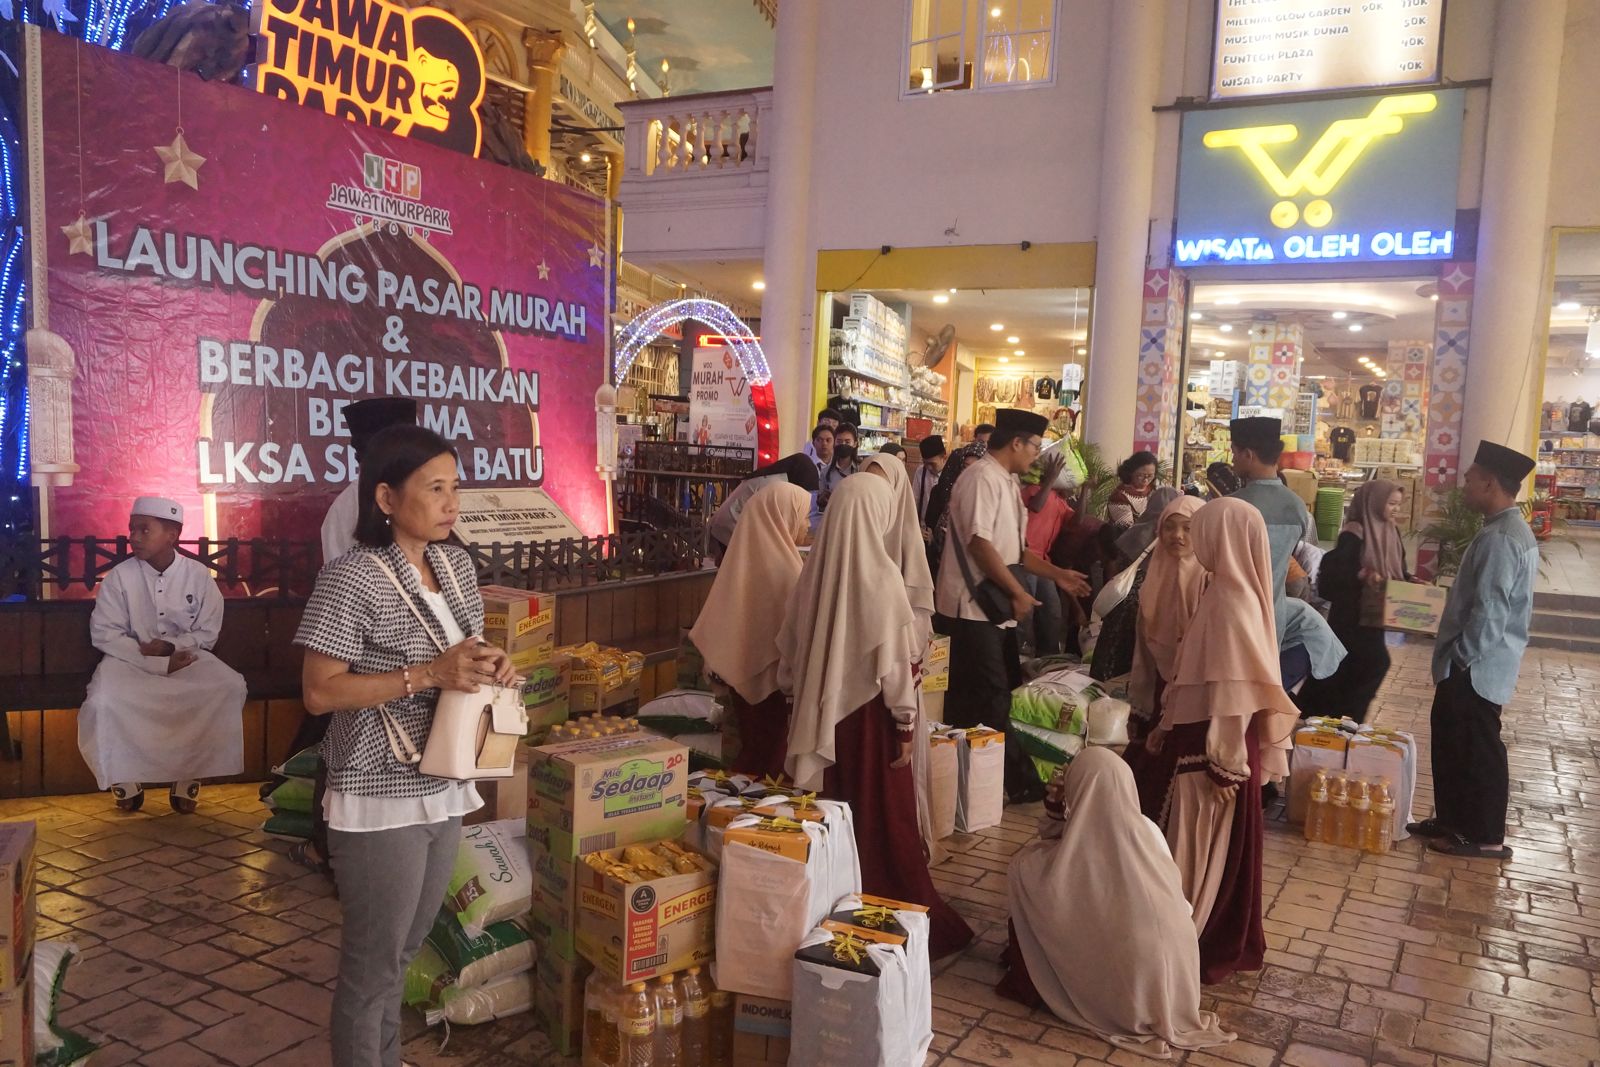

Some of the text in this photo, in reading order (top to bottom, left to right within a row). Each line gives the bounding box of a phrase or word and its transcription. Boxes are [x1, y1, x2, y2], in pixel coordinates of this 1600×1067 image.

[1309, 7, 1351, 18] GARDEN
[270, 0, 409, 61] AWA
[1275, 30, 1309, 39] MUSIK
[1314, 26, 1349, 35] DUNIA
[267, 14, 416, 115] TIMUR
[1223, 52, 1275, 65] FUNTECH
[1278, 50, 1314, 60] PLAZA
[1222, 75, 1264, 88] WISATA
[1266, 72, 1304, 83] PARTY
[331, 184, 450, 227] JAWATIMURPARK
[355, 216, 430, 240] GROUP
[1283, 233, 1361, 259] OLEH
[1370, 231, 1454, 256] OLEH
[96, 220, 587, 337] LAUNCHING PASAR MURAH
[382, 315, 411, 353] &
[200, 340, 539, 405] BERBAGI KEBAIKAN
[693, 371, 724, 385] MURAH
[696, 390, 719, 401] PROMO
[308, 397, 474, 441] BEMA
[198, 440, 315, 484] LKSA
[473, 447, 543, 481] BATU
[460, 513, 490, 523] JAWA
[489, 512, 523, 522] TIMUR
[522, 511, 549, 520] PARK
[519, 612, 550, 633] ENERGEN
[590, 771, 674, 800] Sedaap
[663, 890, 713, 919] ENERGE
